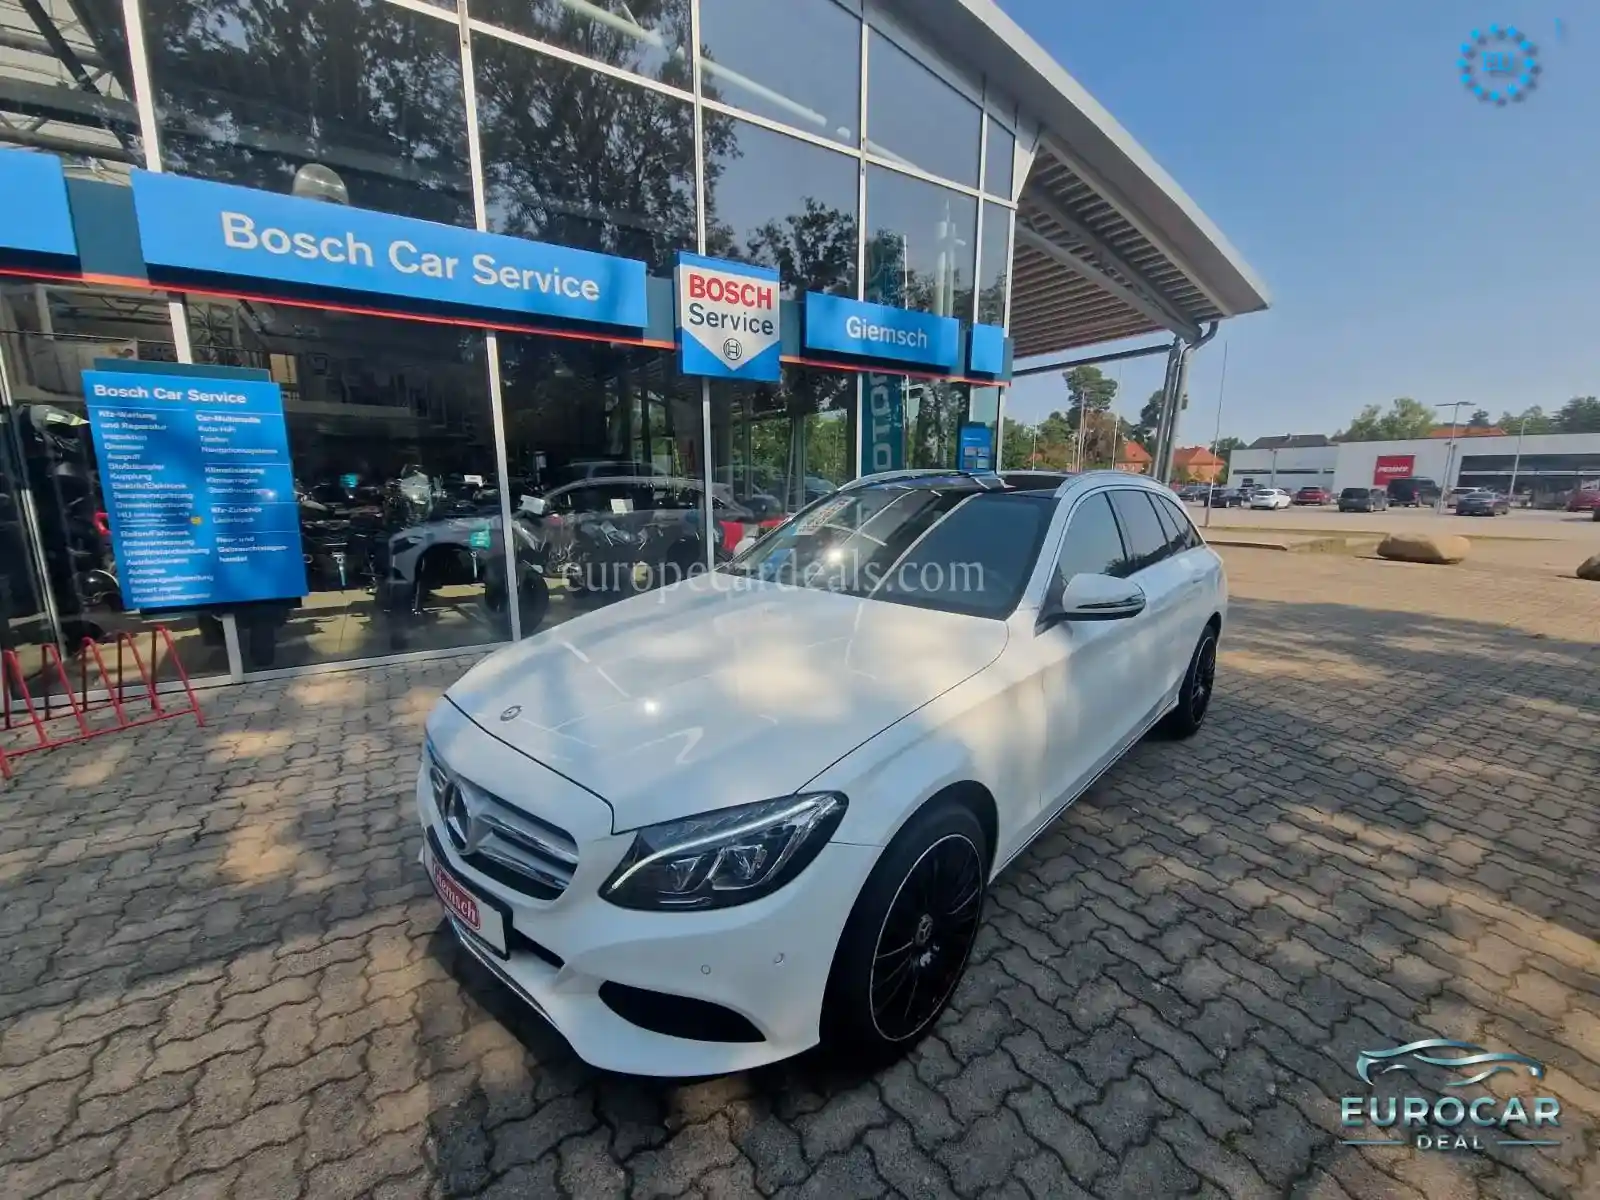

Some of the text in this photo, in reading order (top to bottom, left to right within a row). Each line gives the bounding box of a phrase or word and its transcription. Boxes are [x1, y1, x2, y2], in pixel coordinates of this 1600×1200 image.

[221, 211, 600, 301] Bosch Car Service
[689, 273, 772, 310] BOSCH
[689, 302, 774, 335] Service
[846, 315, 927, 349] Giemsch
[93, 384, 247, 404] Bosch Car Service
